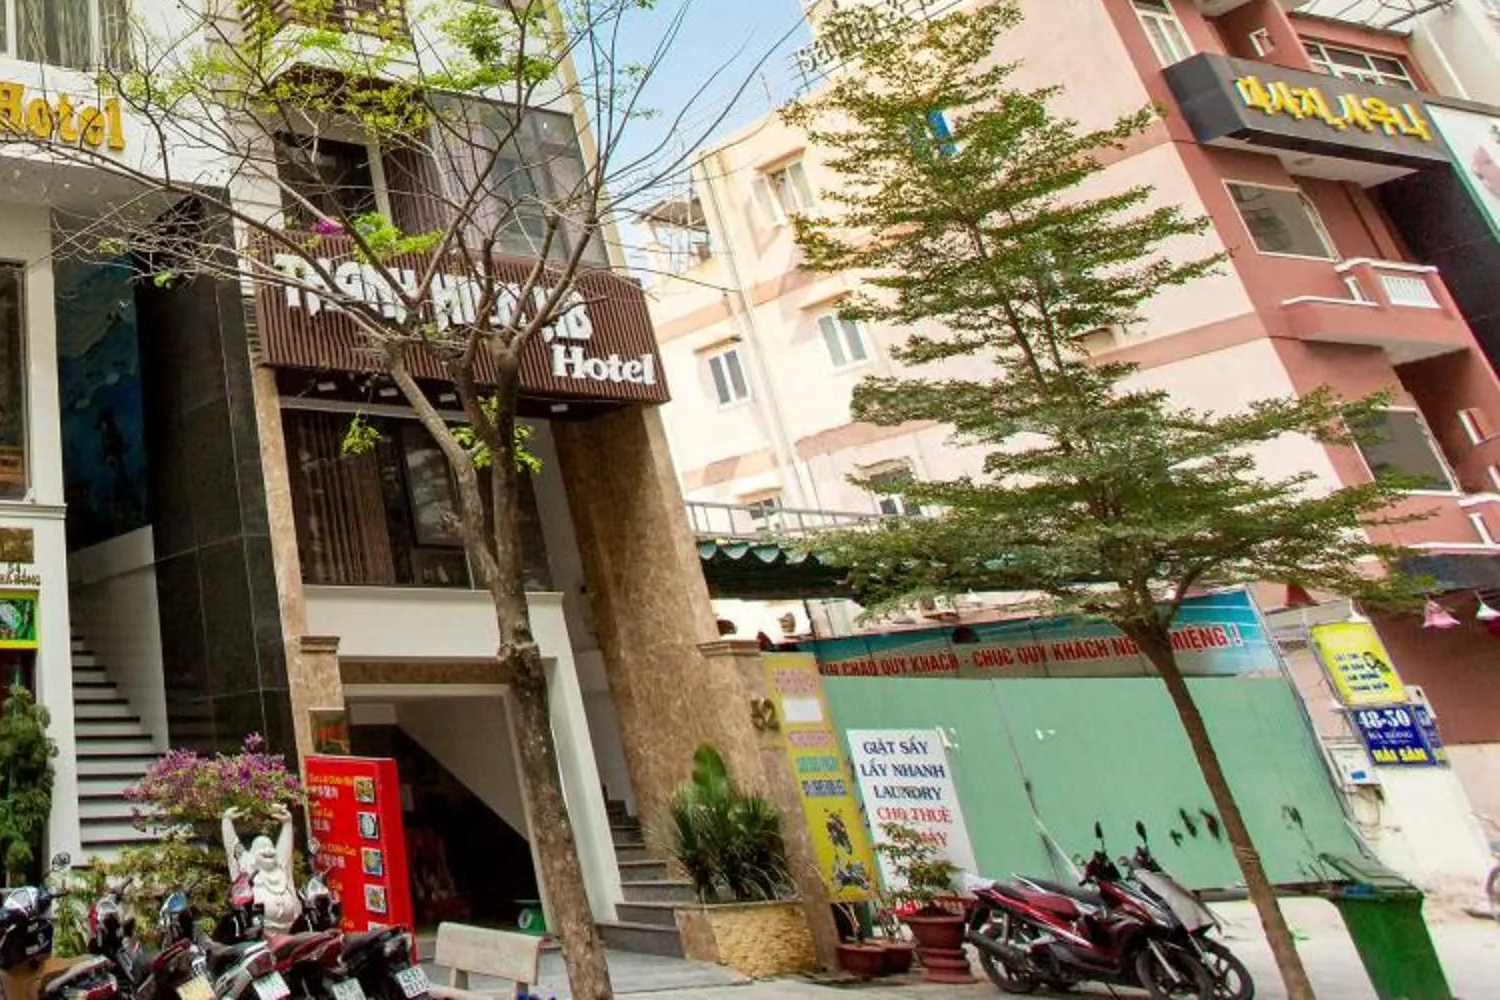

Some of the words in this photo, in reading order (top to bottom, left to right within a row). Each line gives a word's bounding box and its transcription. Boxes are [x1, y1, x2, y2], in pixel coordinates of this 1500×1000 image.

[550, 342, 658, 387] Hotel
[891, 763, 947, 778] NHANH
[873, 784, 942, 801] LAUNDRY
